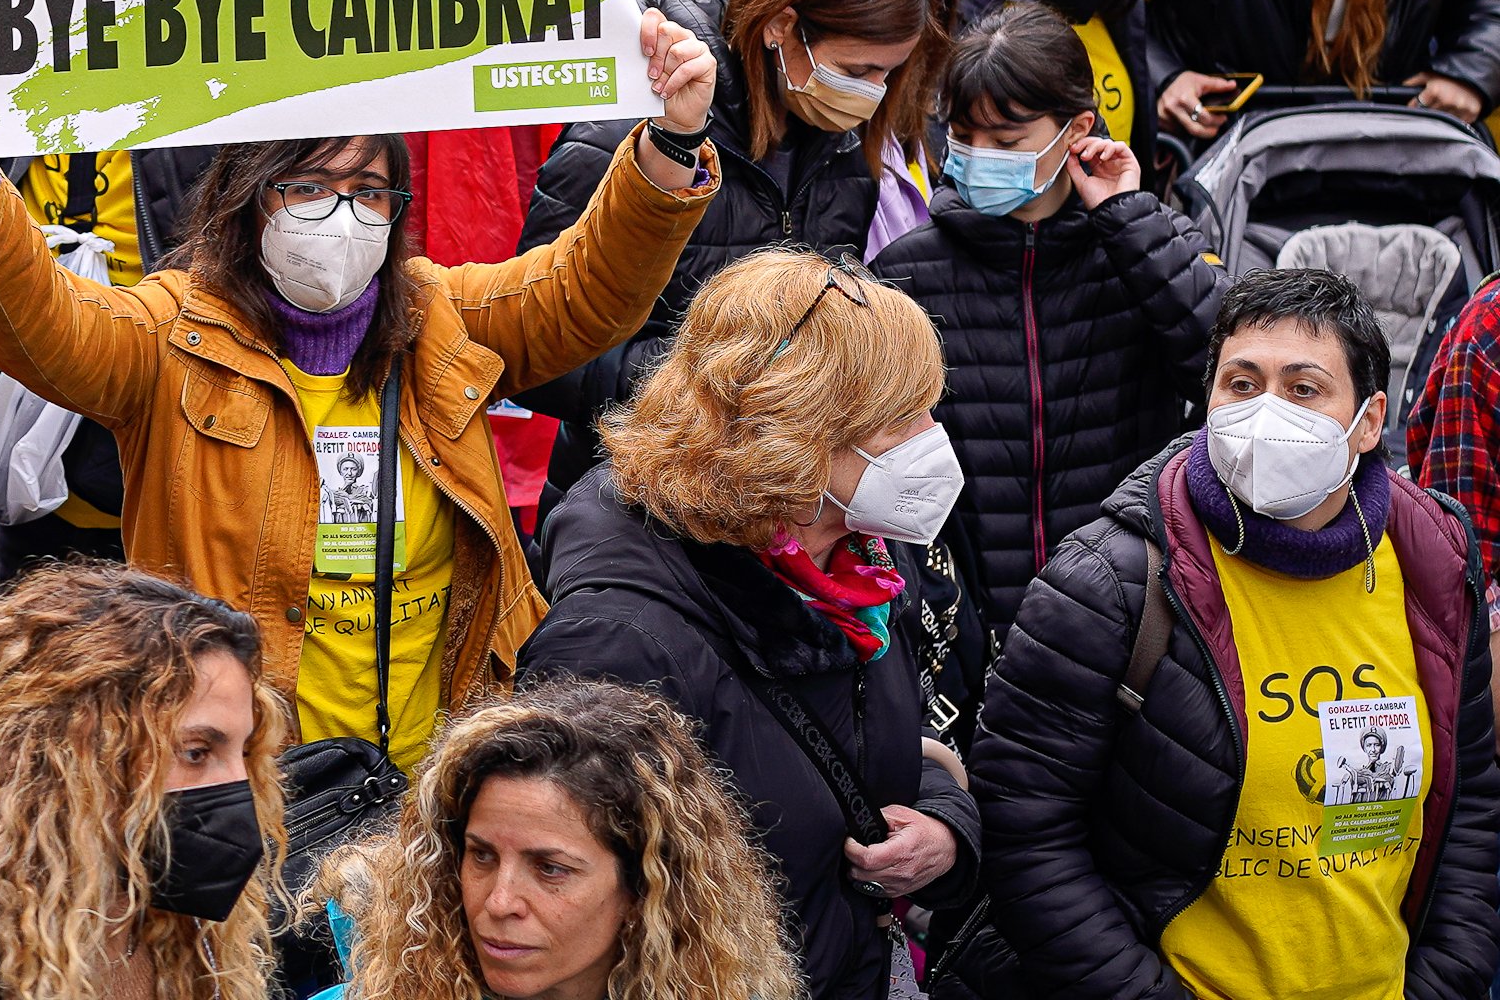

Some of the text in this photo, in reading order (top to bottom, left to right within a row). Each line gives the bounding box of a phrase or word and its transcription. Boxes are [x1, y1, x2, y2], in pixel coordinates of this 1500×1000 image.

[589, 85, 611, 98] IAC
[323, 442, 345, 453] PETIT
[1258, 664, 1386, 724] SOS
[1374, 701, 1407, 712] CAMBRAY
[1330, 713, 1410, 730] EL PETIT DICTADOR
[1278, 858, 1311, 878] DE
